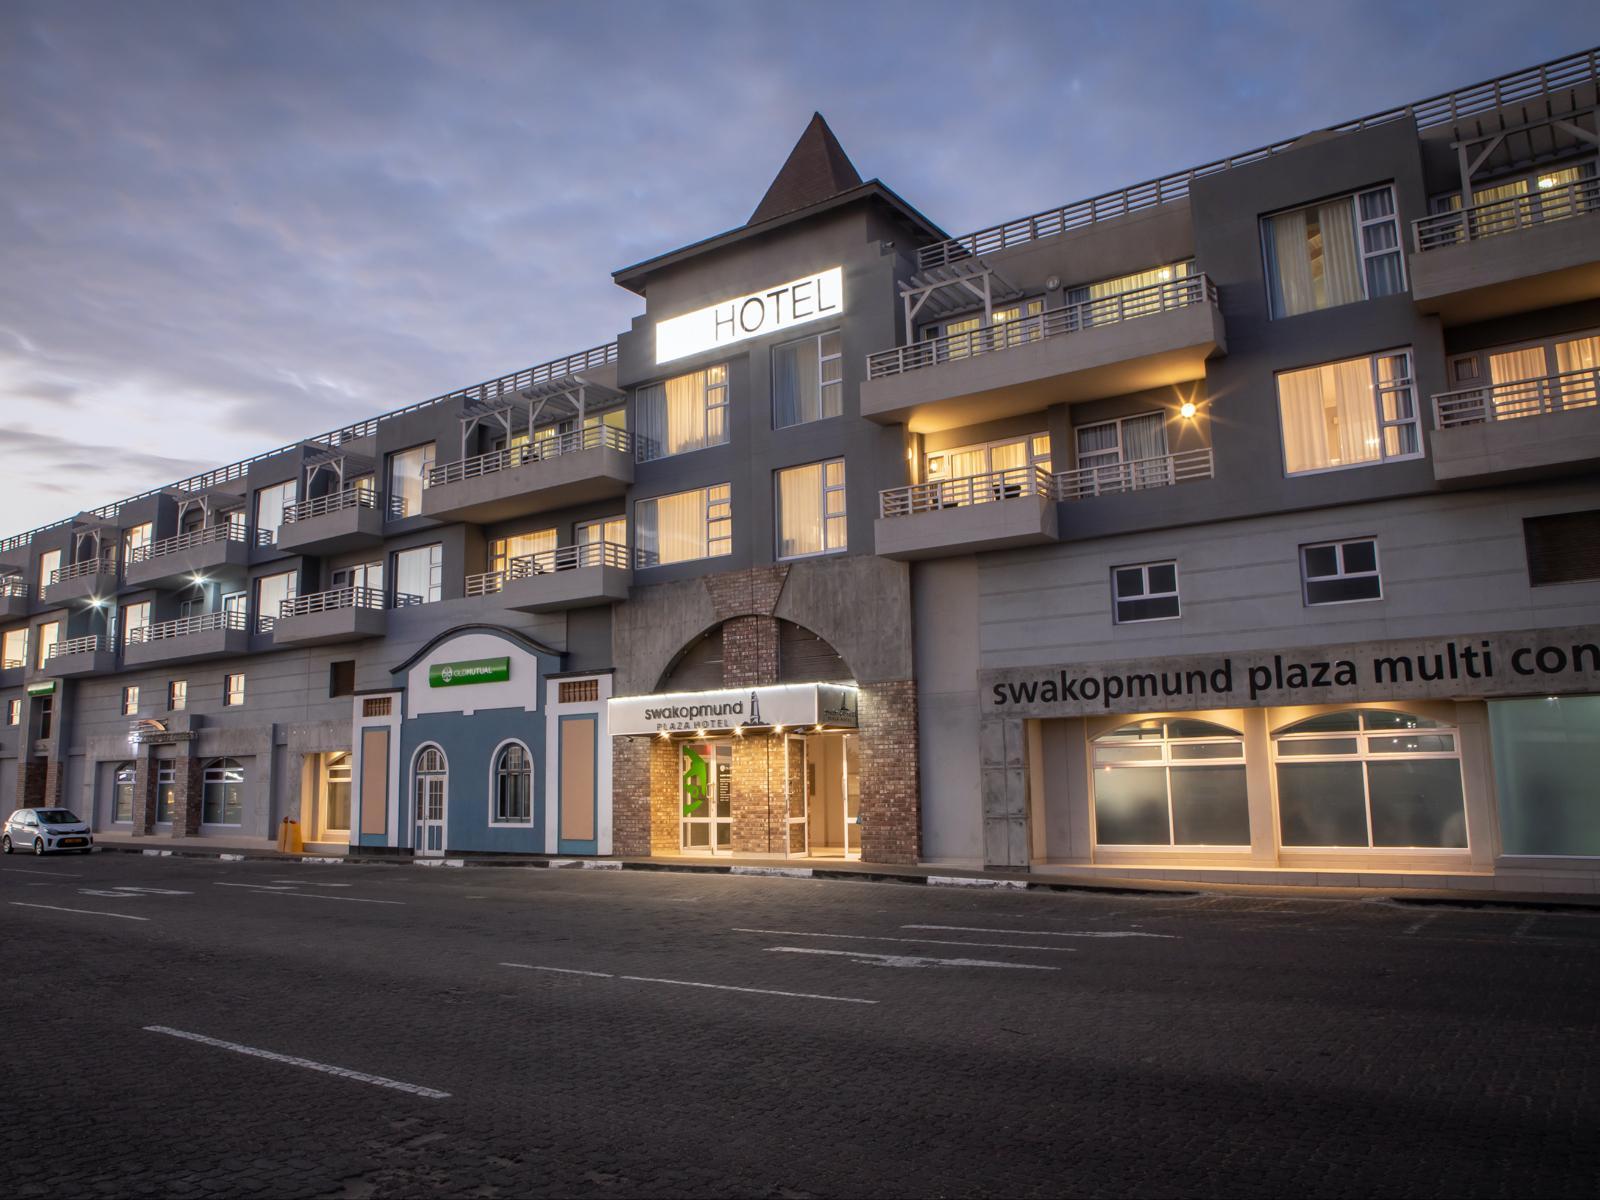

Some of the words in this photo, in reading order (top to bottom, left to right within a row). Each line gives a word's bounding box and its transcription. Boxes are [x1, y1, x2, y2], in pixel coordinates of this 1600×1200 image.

[714, 278, 836, 341] HOTEL
[993, 658, 1233, 708] swakopmund
[1248, 654, 1357, 701] plaza
[1373, 640, 1494, 684] multi
[644, 700, 743, 721] swakopmund
[656, 721, 691, 731] PLAZA
[693, 719, 729, 730] HOTEL
